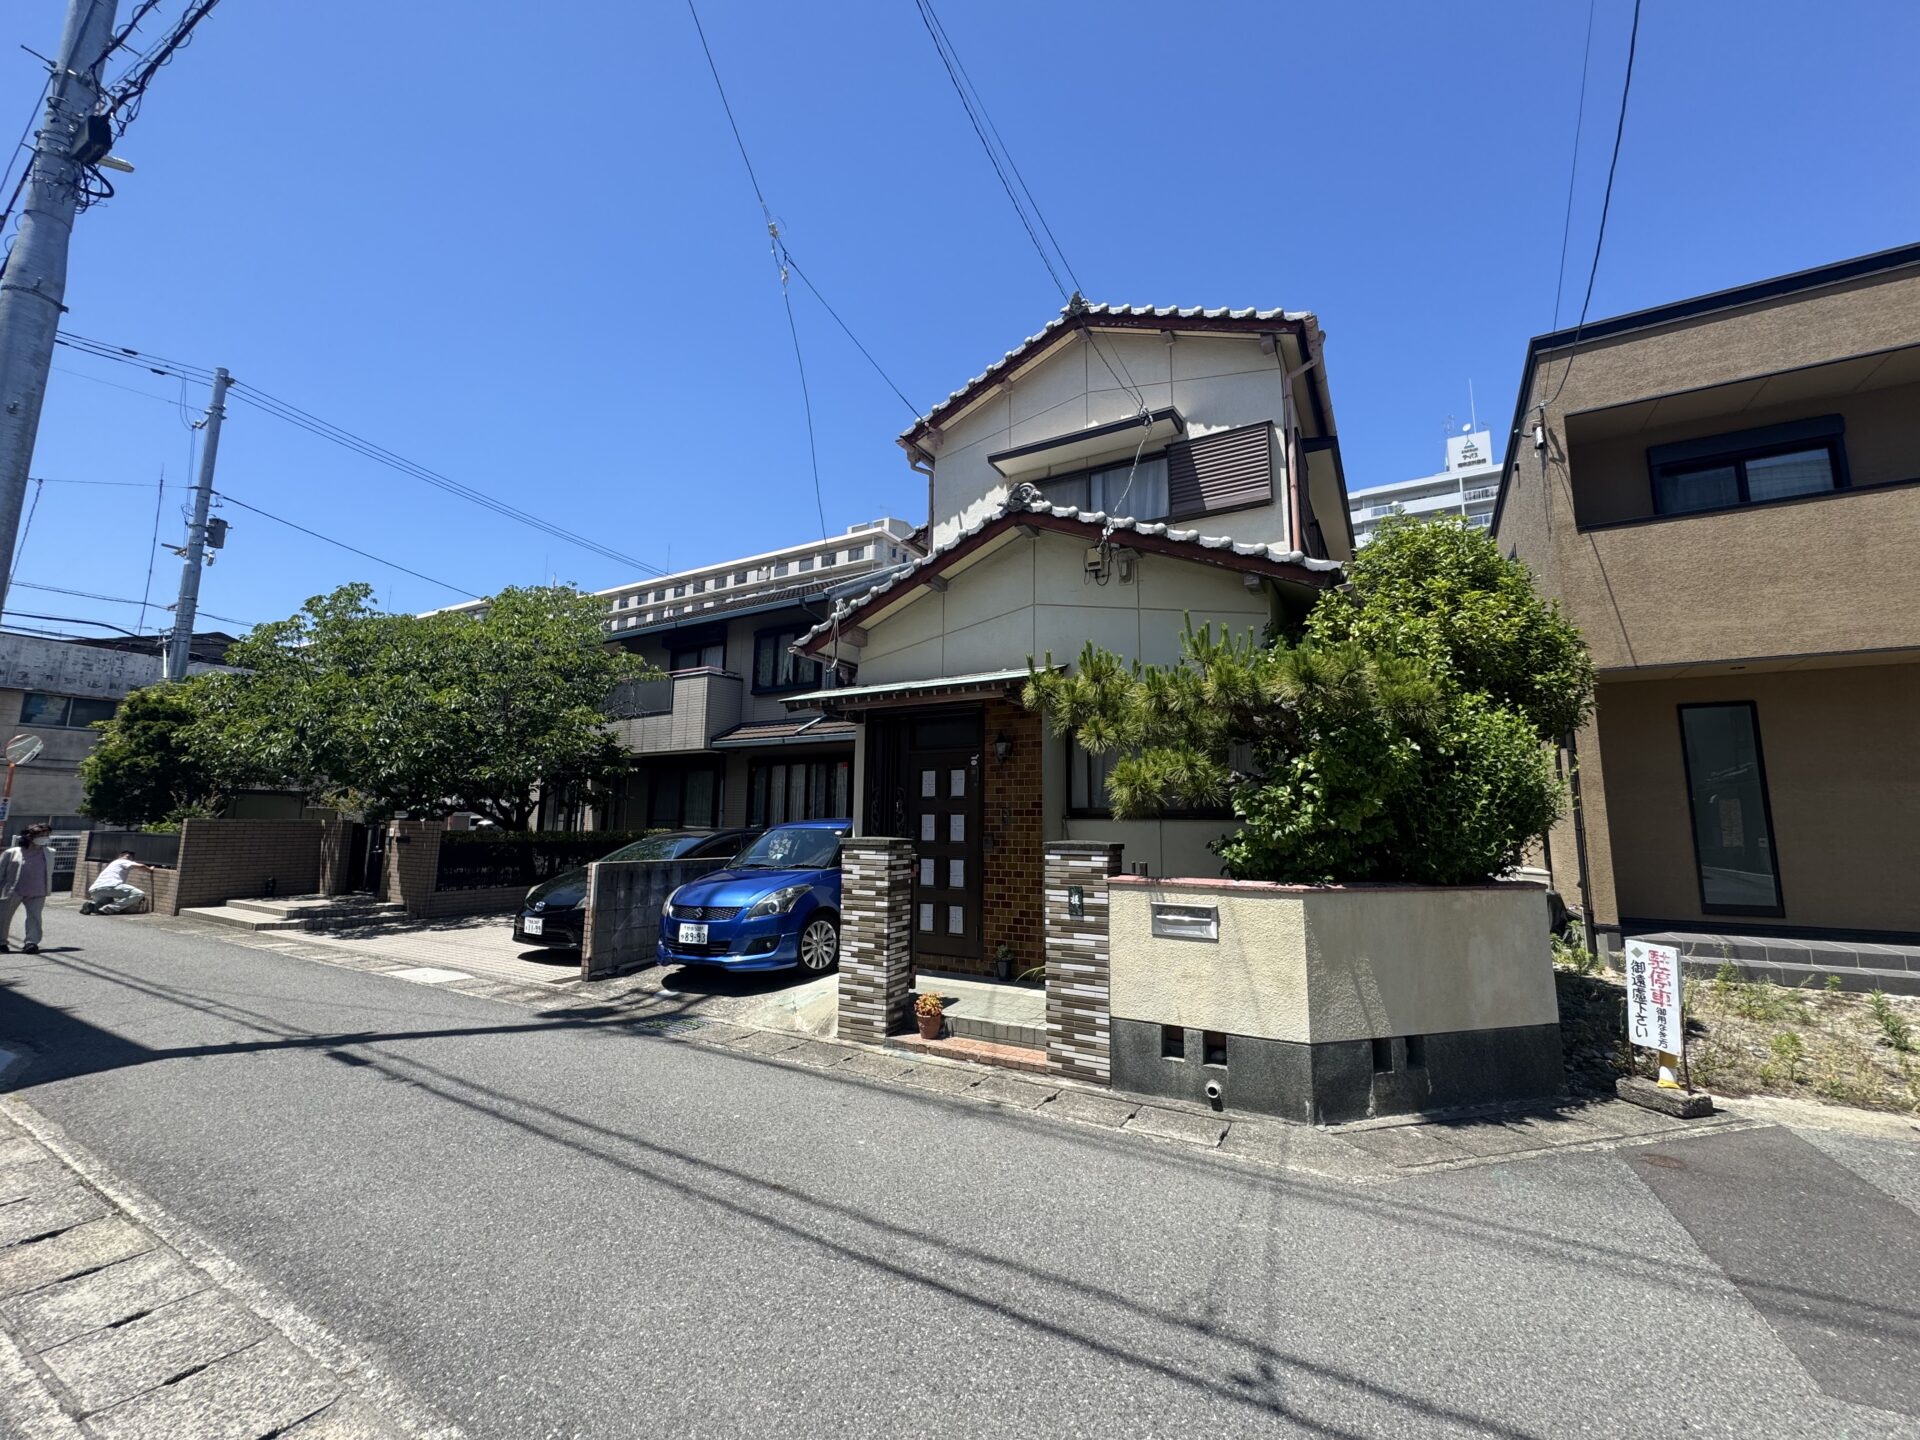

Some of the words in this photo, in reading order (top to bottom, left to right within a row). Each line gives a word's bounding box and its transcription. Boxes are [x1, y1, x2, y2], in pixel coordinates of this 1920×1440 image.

[685, 932, 706, 943] 89-93
[1631, 960, 1648, 1038] 御遠慮下さい
[1648, 949, 1672, 1007] 駐停車
[1656, 1007, 1669, 1049] 御用なき方
